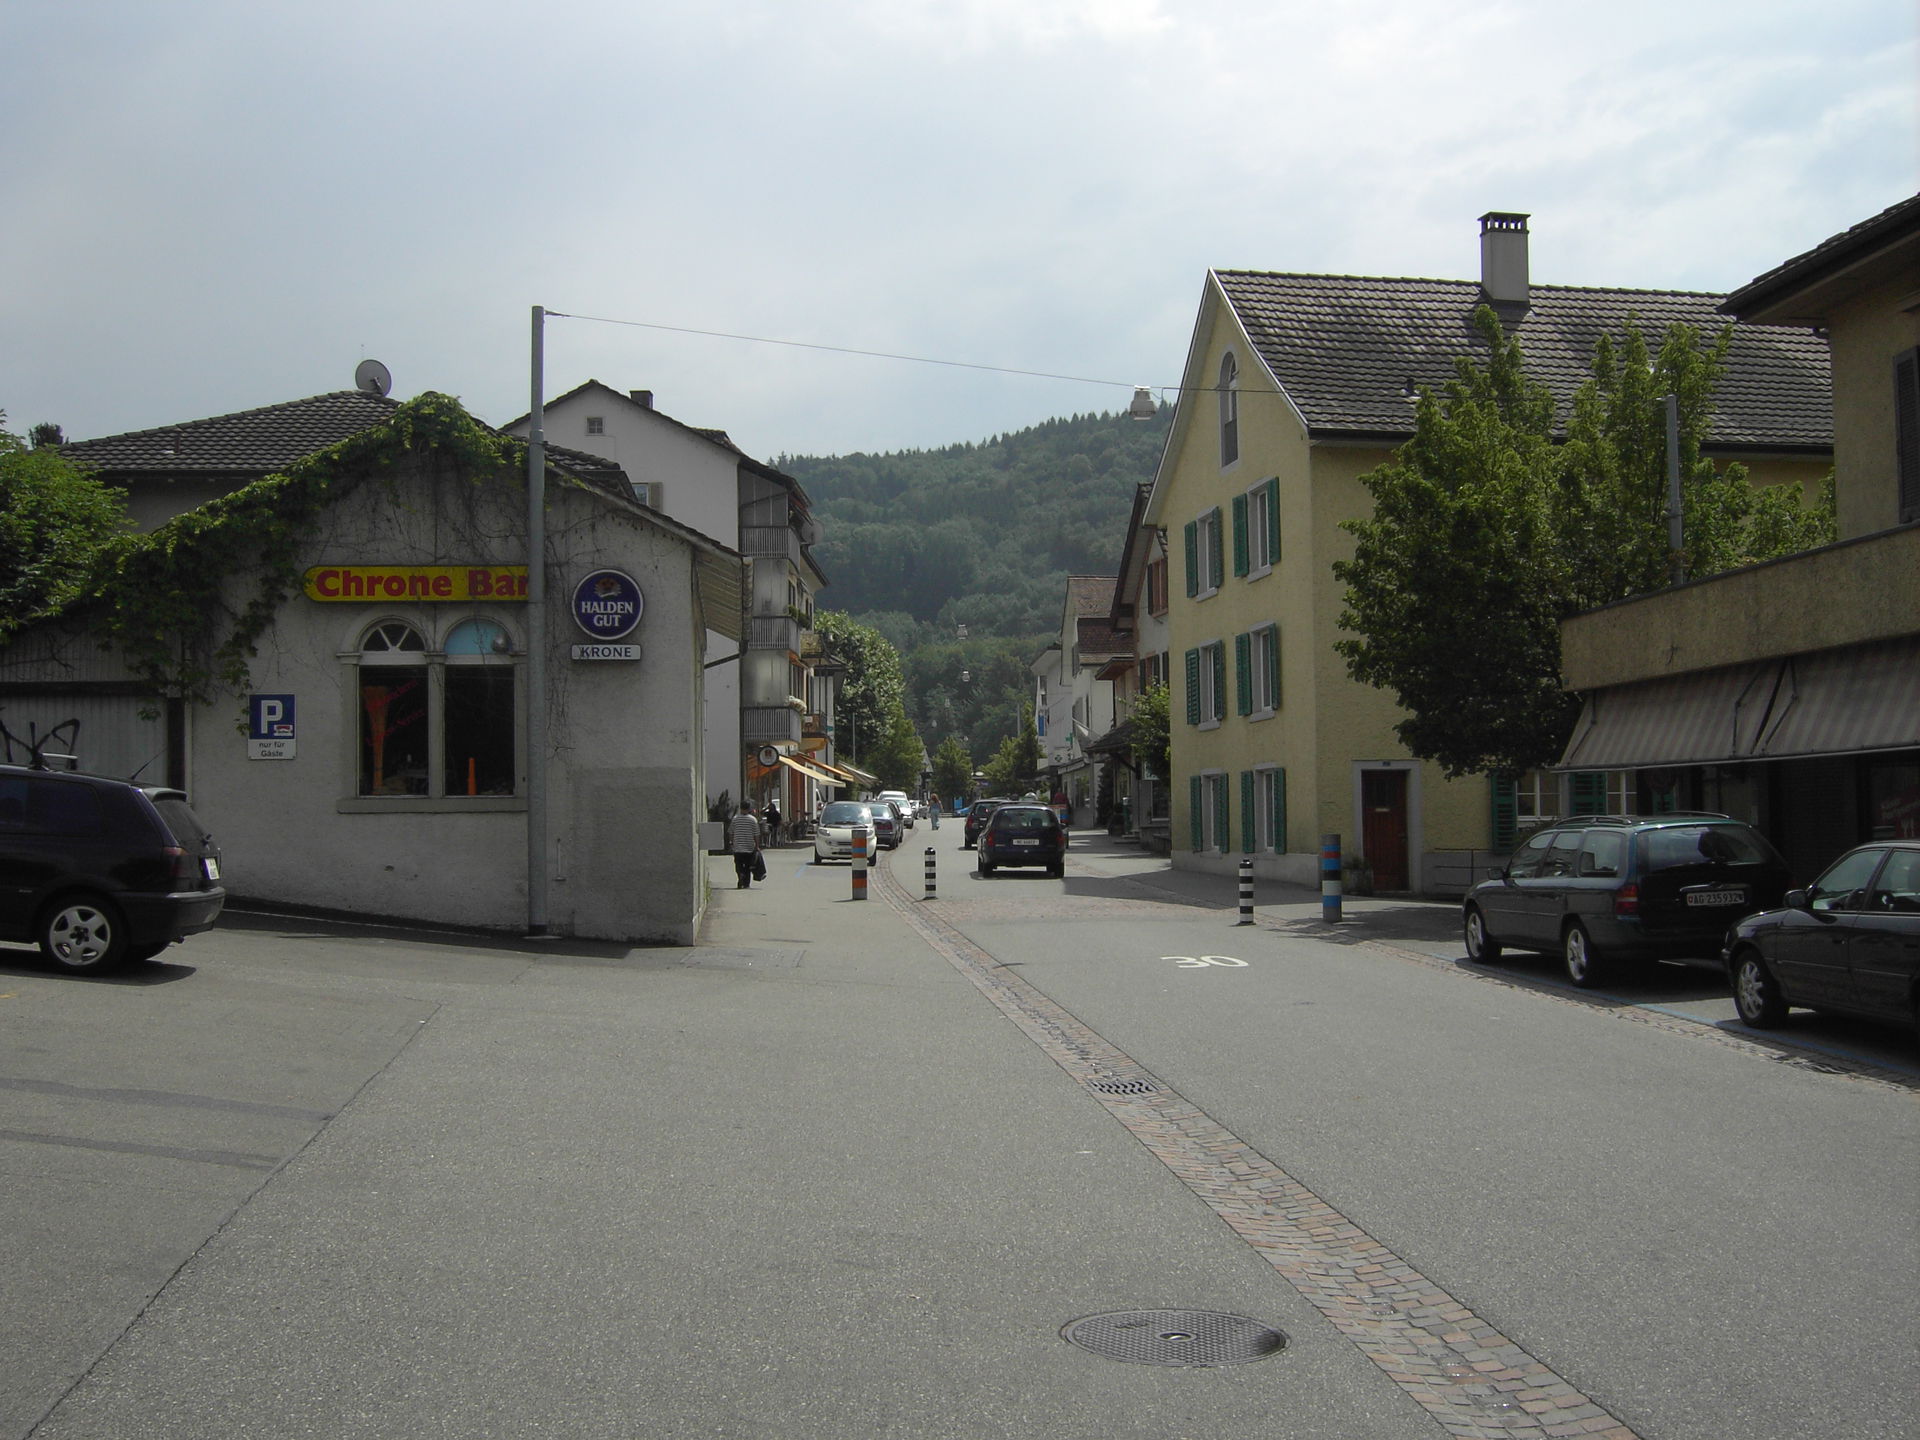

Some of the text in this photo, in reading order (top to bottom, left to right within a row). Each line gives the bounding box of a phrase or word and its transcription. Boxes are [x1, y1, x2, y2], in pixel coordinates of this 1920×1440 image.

[315, 569, 529, 597] Chrone Bar
[581, 601, 634, 614] HALDEN
[593, 614, 622, 627] GUT
[581, 646, 632, 658] KRONE
[260, 699, 283, 734] P
[260, 749, 284, 757] Gäste
[1160, 955, 1249, 968] 30
